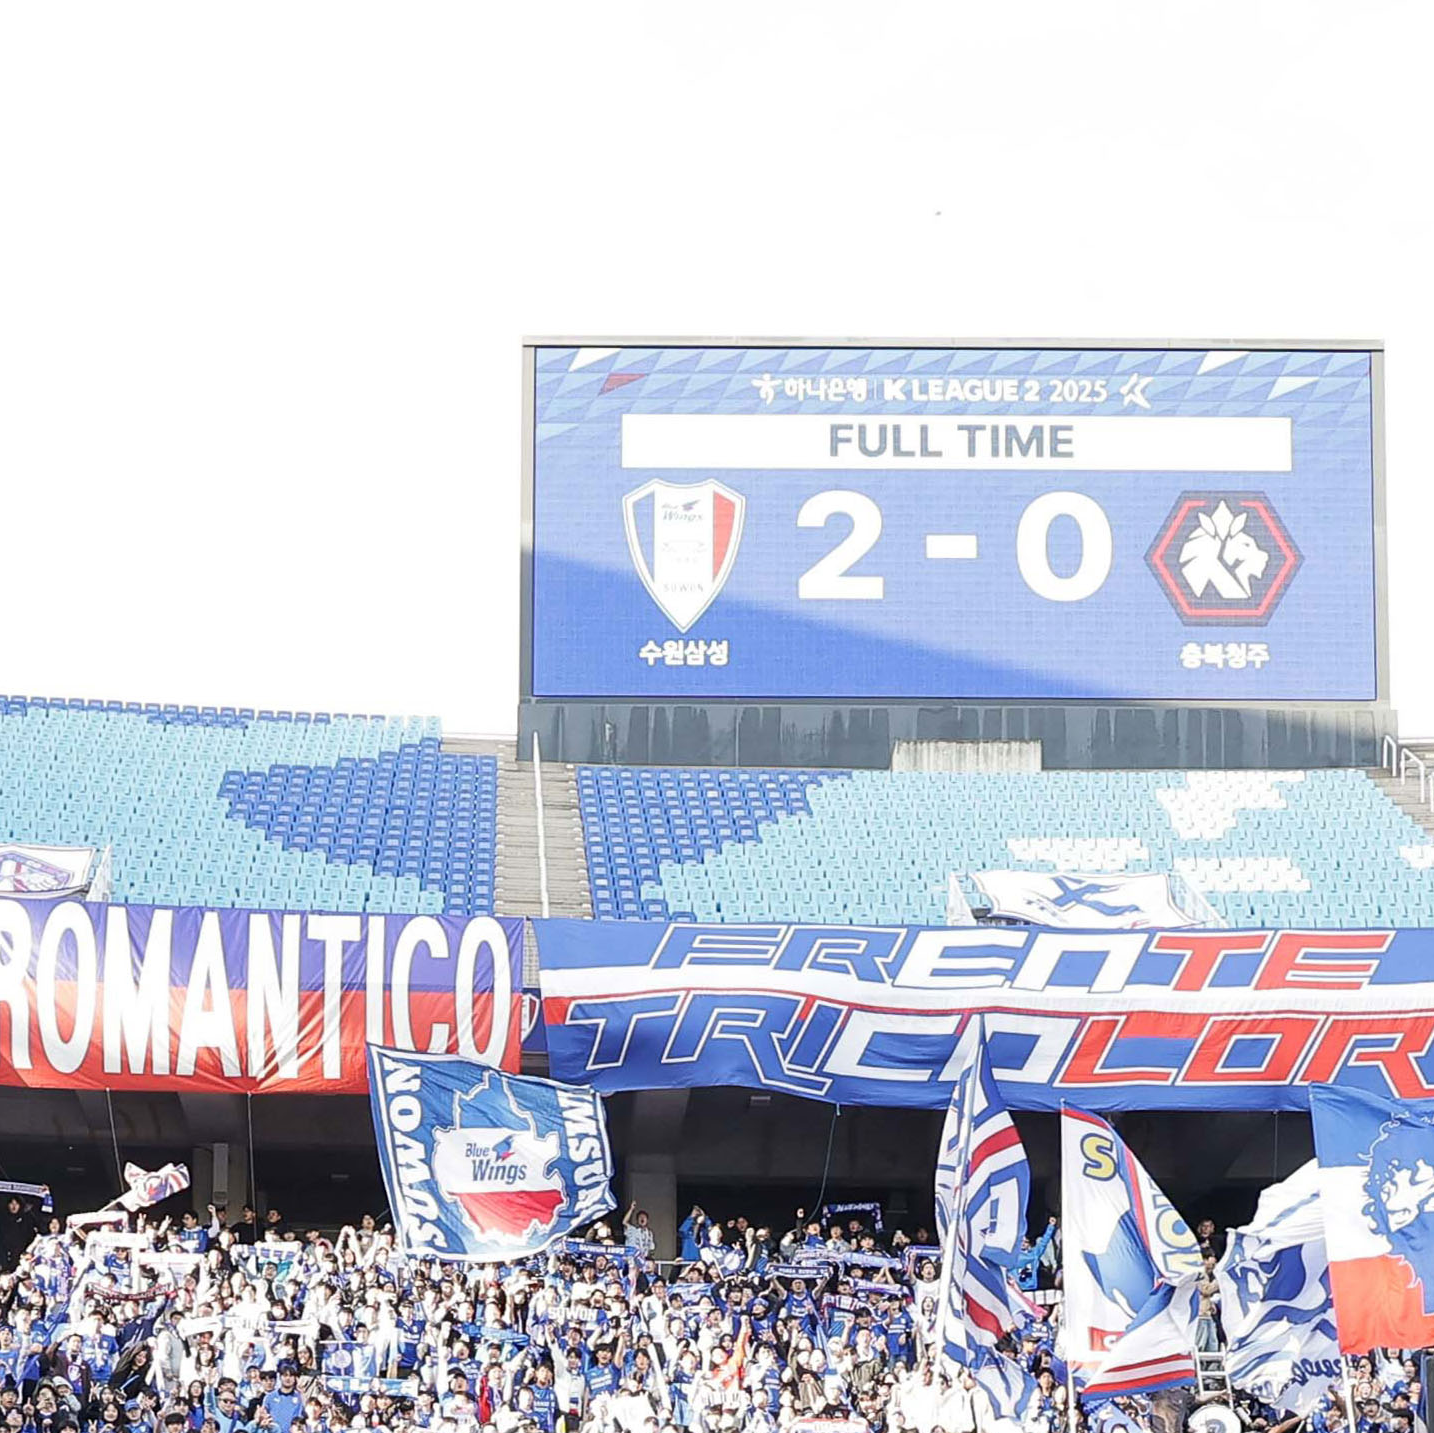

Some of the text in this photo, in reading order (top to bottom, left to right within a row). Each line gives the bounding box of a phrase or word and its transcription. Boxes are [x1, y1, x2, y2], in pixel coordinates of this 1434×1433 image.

[784, 378, 867, 402] 하나은행
[882, 379, 1108, 403] K LEAGUE 2 2025
[829, 423, 1075, 459] FULL TIME
[796, 489, 885, 600] 2
[1016, 490, 1113, 602] 0
[638, 639, 730, 667] 수원삼성
[650, 922, 1396, 994] FRENTE
[381, 1053, 449, 1249] SUWON
[465, 1142, 490, 1159] Blue
[471, 1160, 528, 1186] Wings
